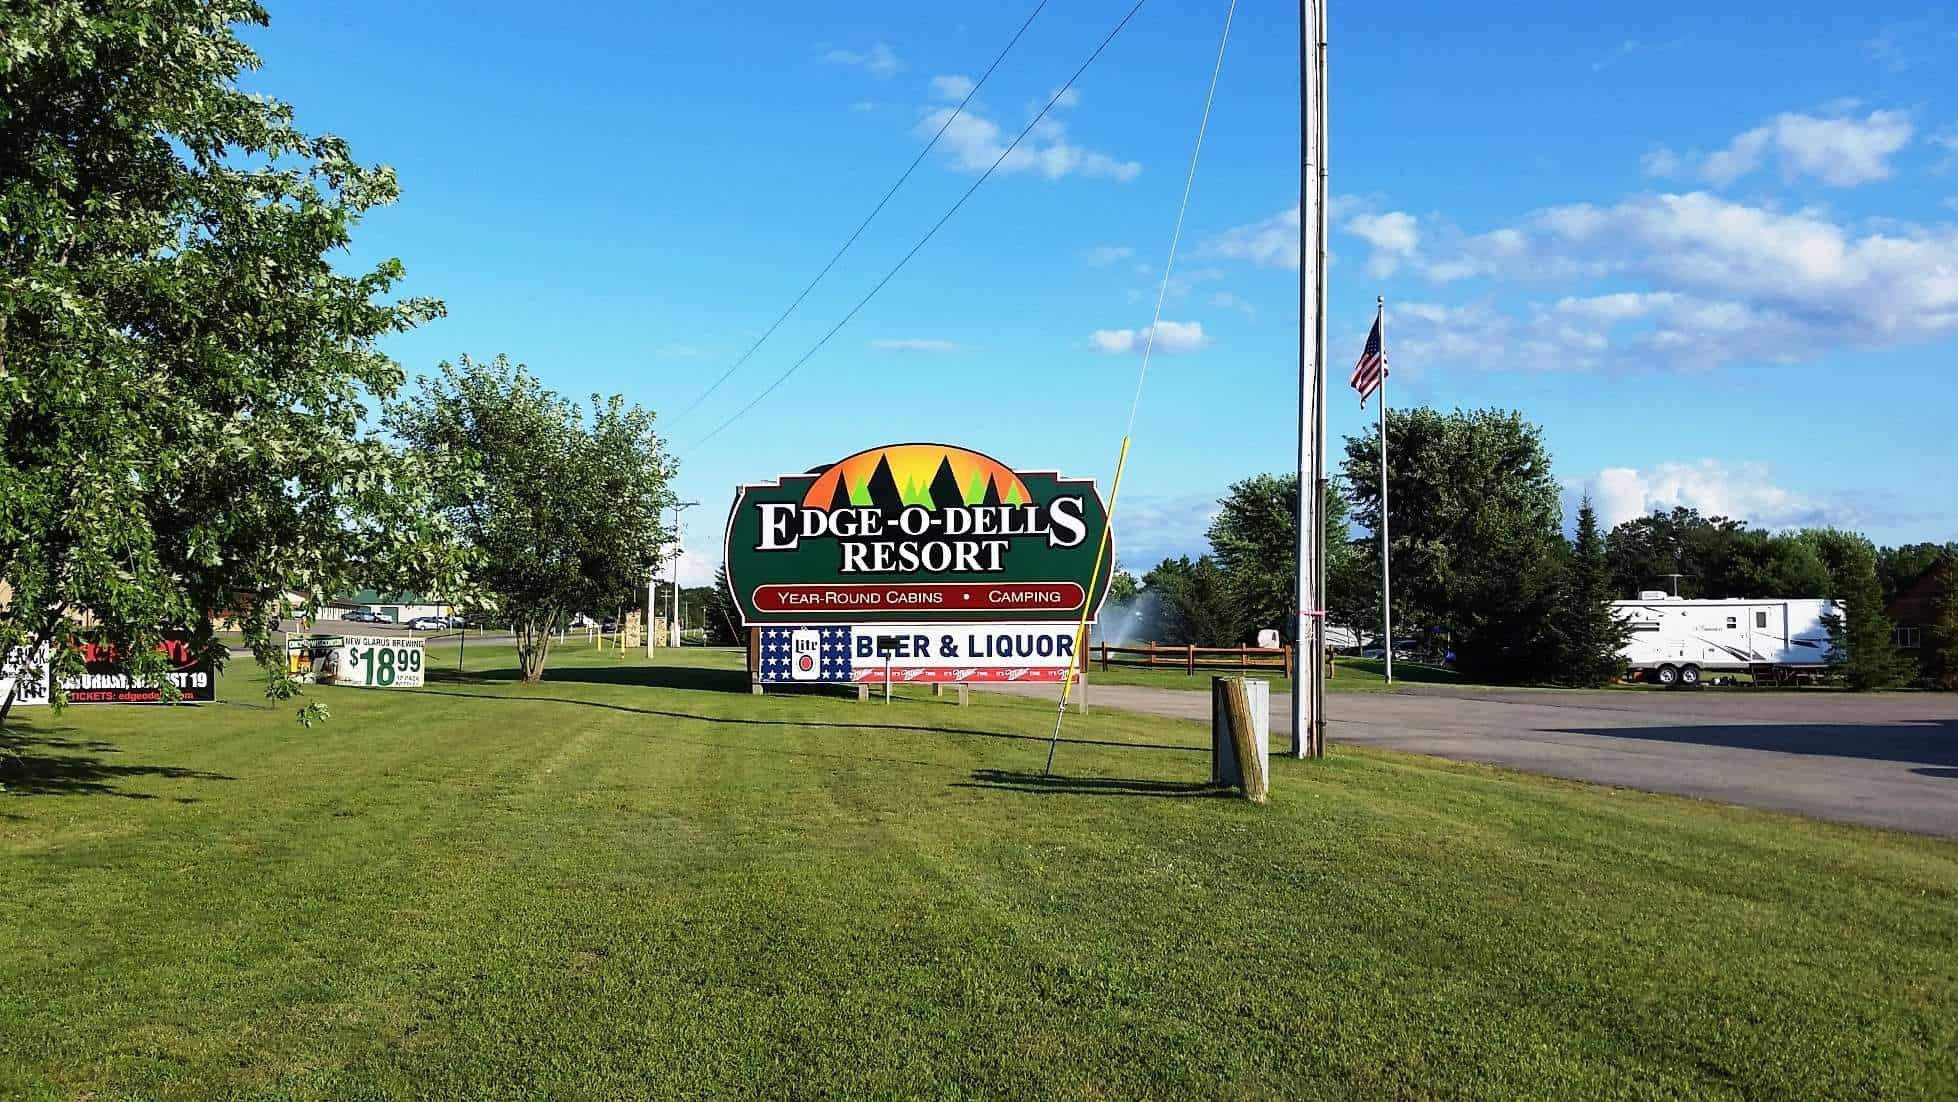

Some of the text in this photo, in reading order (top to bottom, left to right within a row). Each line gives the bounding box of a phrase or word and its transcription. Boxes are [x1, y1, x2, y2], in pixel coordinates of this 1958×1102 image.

[755, 496, 1086, 549] EDGE-O-DELLS
[841, 541, 1009, 572] RESORT
[777, 589, 1061, 605] YEAR-ROUND CABINS CAMPING
[346, 637, 361, 645] NEW
[363, 638, 390, 647] GLARUS
[939, 634, 959, 658] &
[968, 634, 1074, 658] LIQUOR
[132, 672, 188, 689] AUST
[190, 671, 208, 688] 19
[118, 691, 194, 700] edgeodeom
